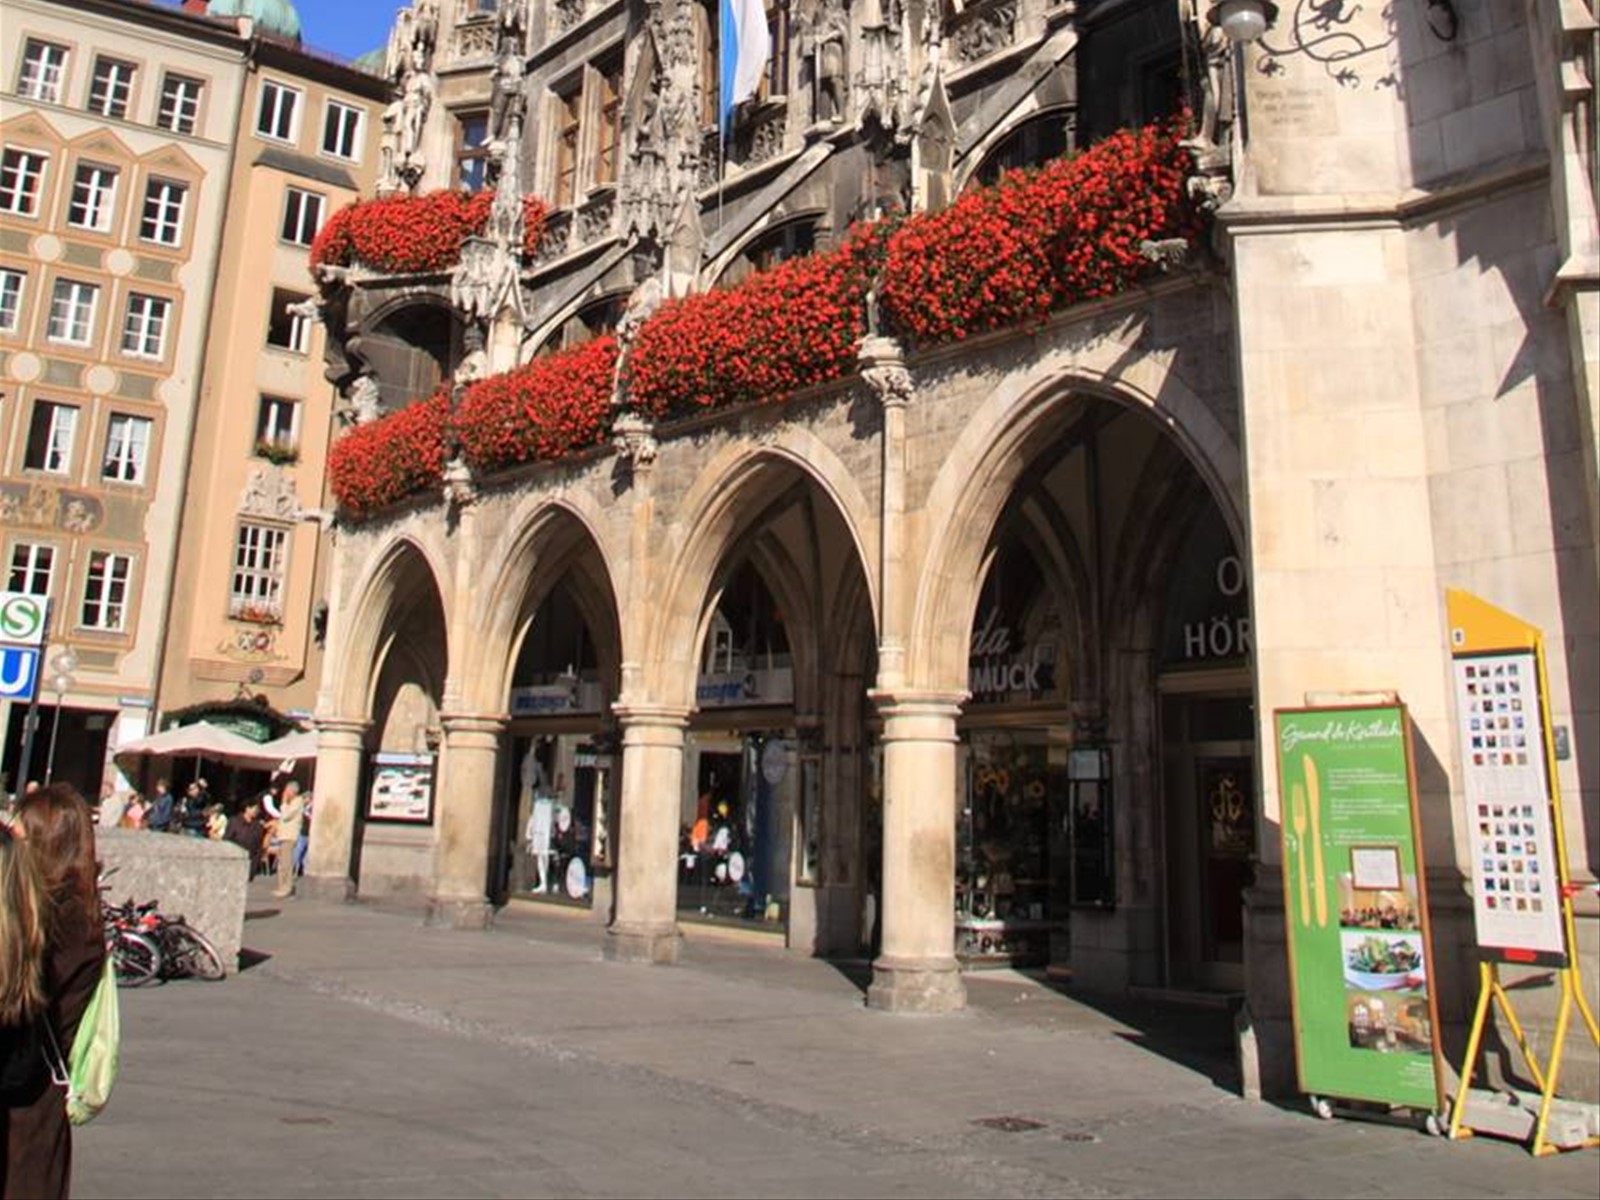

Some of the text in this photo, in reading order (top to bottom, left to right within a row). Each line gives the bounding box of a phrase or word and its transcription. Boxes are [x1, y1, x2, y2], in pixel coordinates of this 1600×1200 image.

[3, 598, 39, 638] S
[0, 648, 32, 695] U
[970, 659, 1040, 693] MUCK
